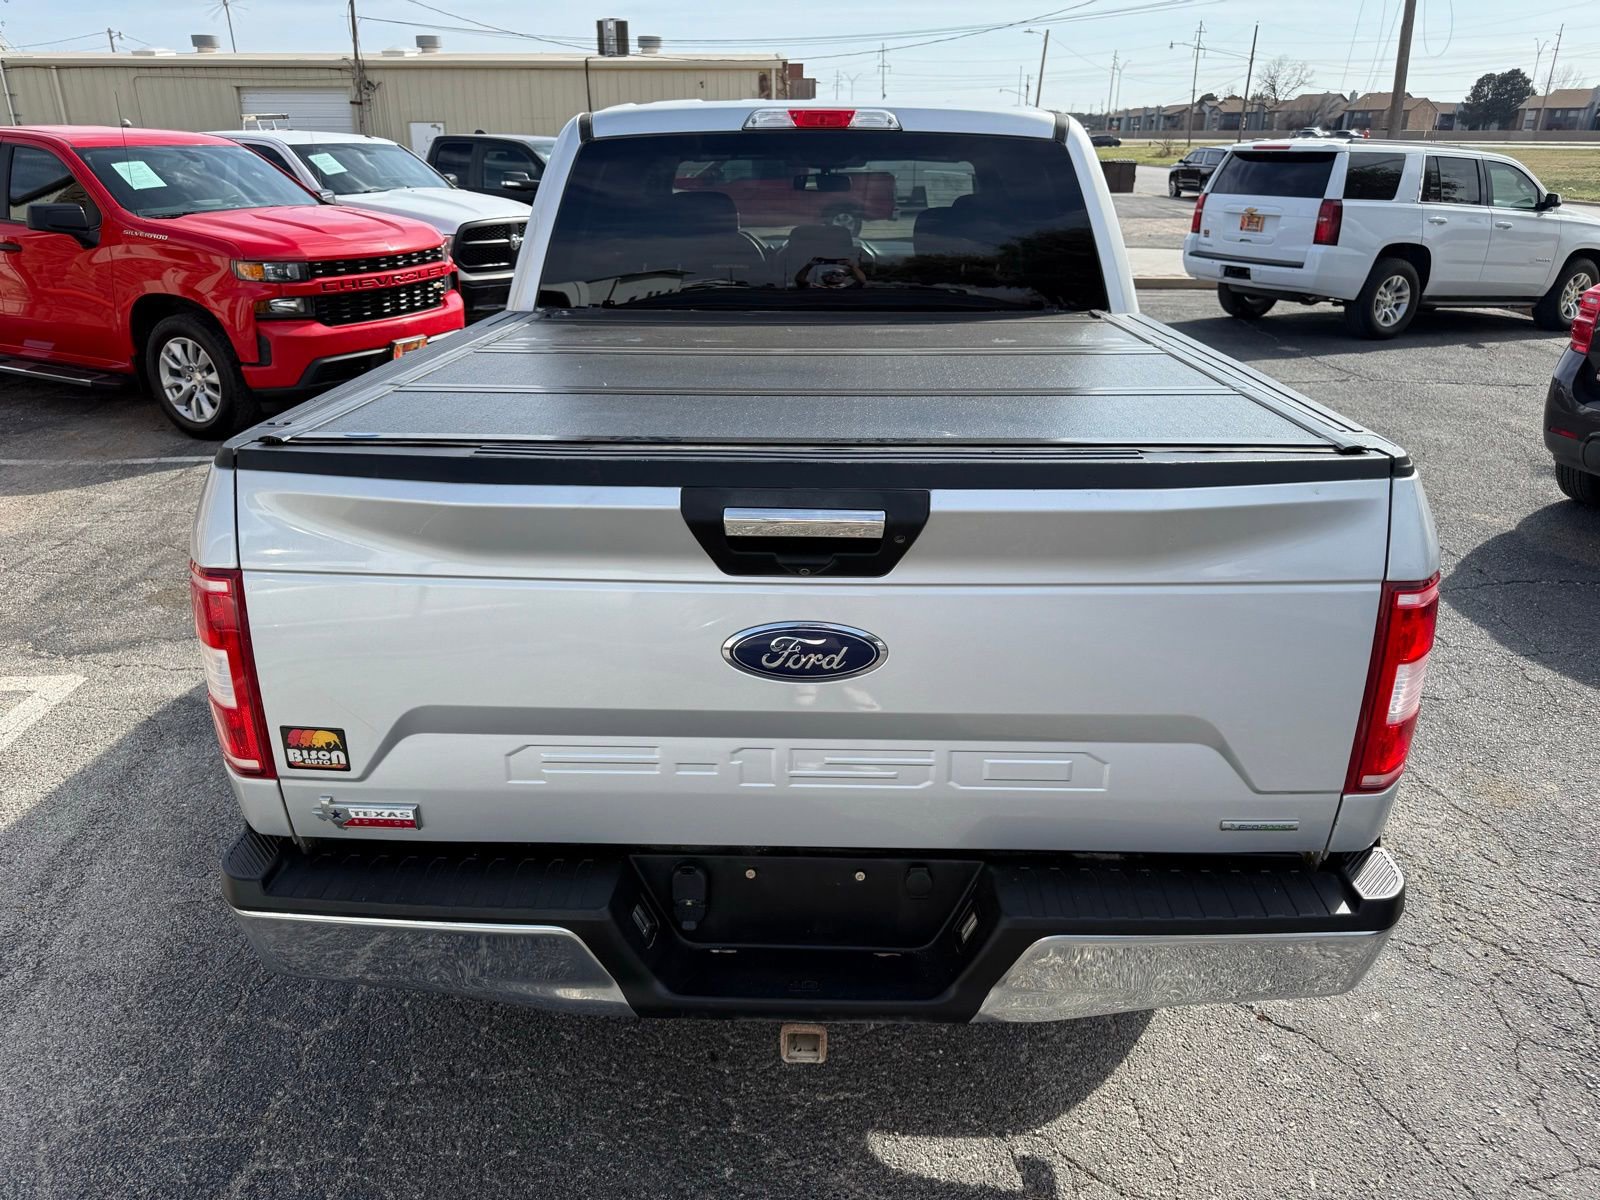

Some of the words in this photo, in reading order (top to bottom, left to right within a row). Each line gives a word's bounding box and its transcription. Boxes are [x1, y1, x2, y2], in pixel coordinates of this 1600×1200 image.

[122, 229, 169, 241] SILVERADO
[321, 264, 447, 292] CHEVROLET
[760, 635, 849, 673] Ford
[506, 744, 1109, 792] F-150
